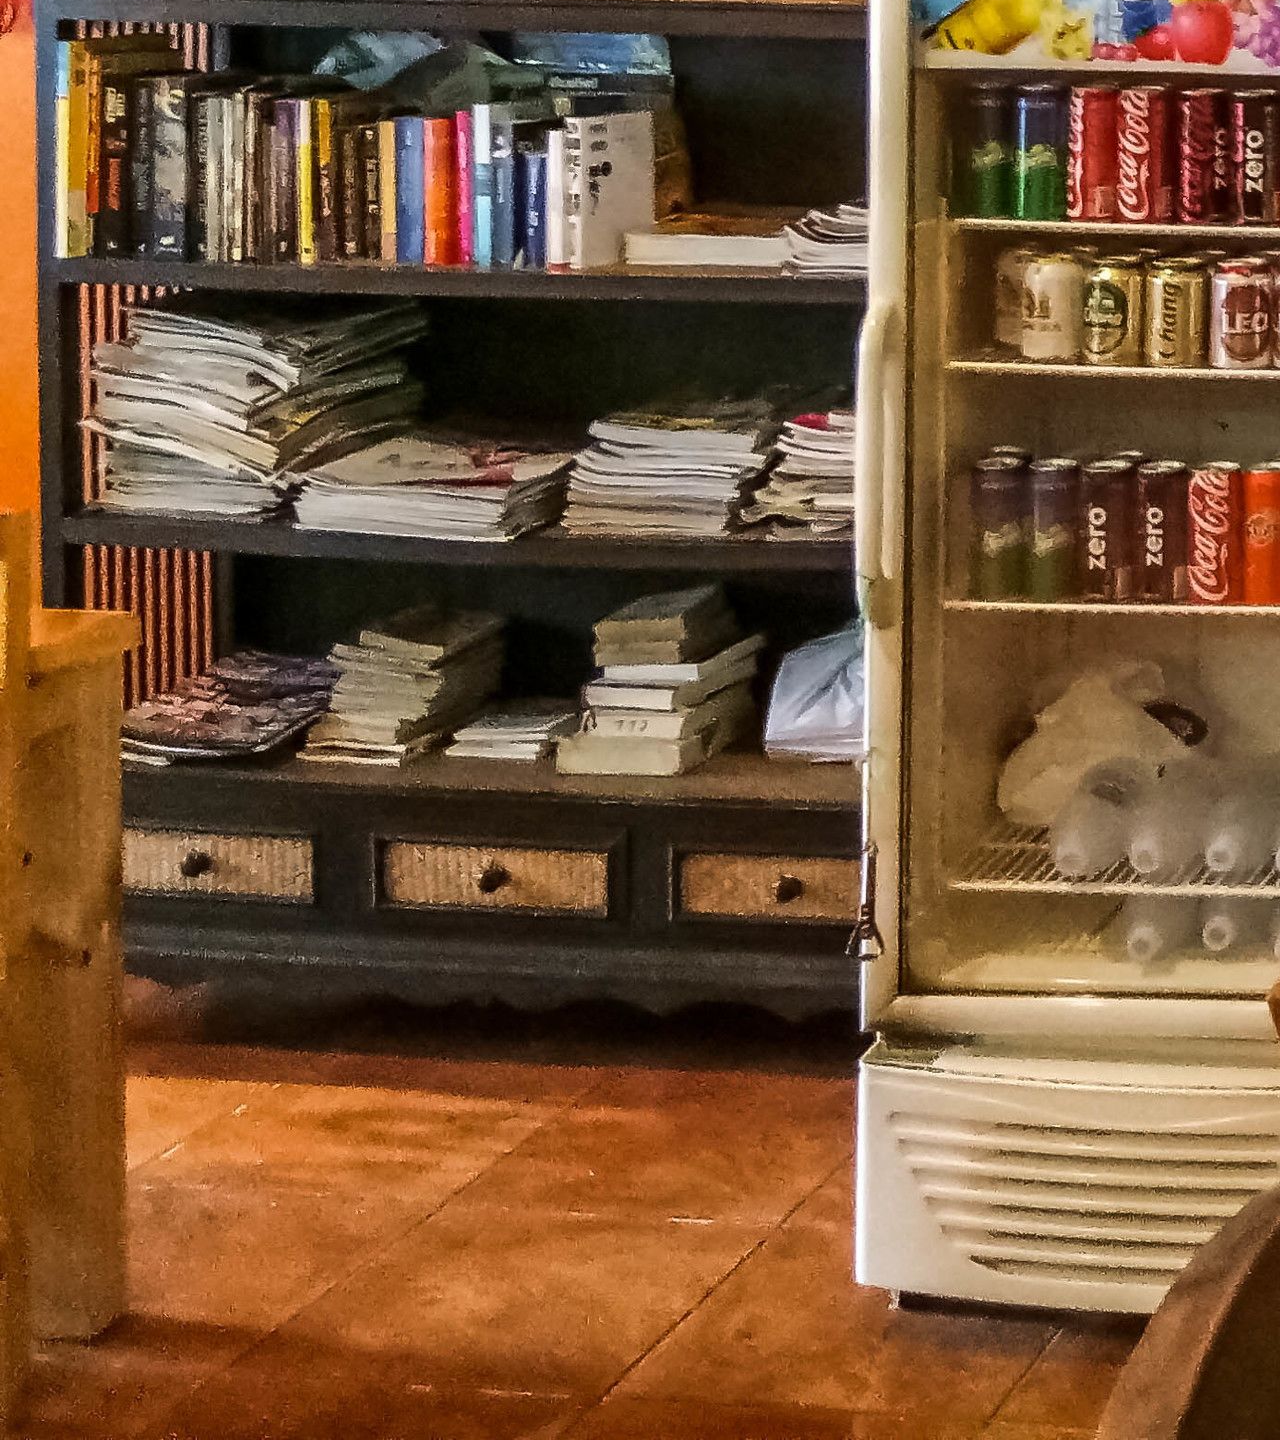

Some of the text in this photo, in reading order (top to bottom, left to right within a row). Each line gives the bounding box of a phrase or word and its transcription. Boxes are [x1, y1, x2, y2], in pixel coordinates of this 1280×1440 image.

[1244, 129, 1265, 193] zero
[1088, 506, 1107, 571] zero
[1145, 506, 1164, 567] zero
